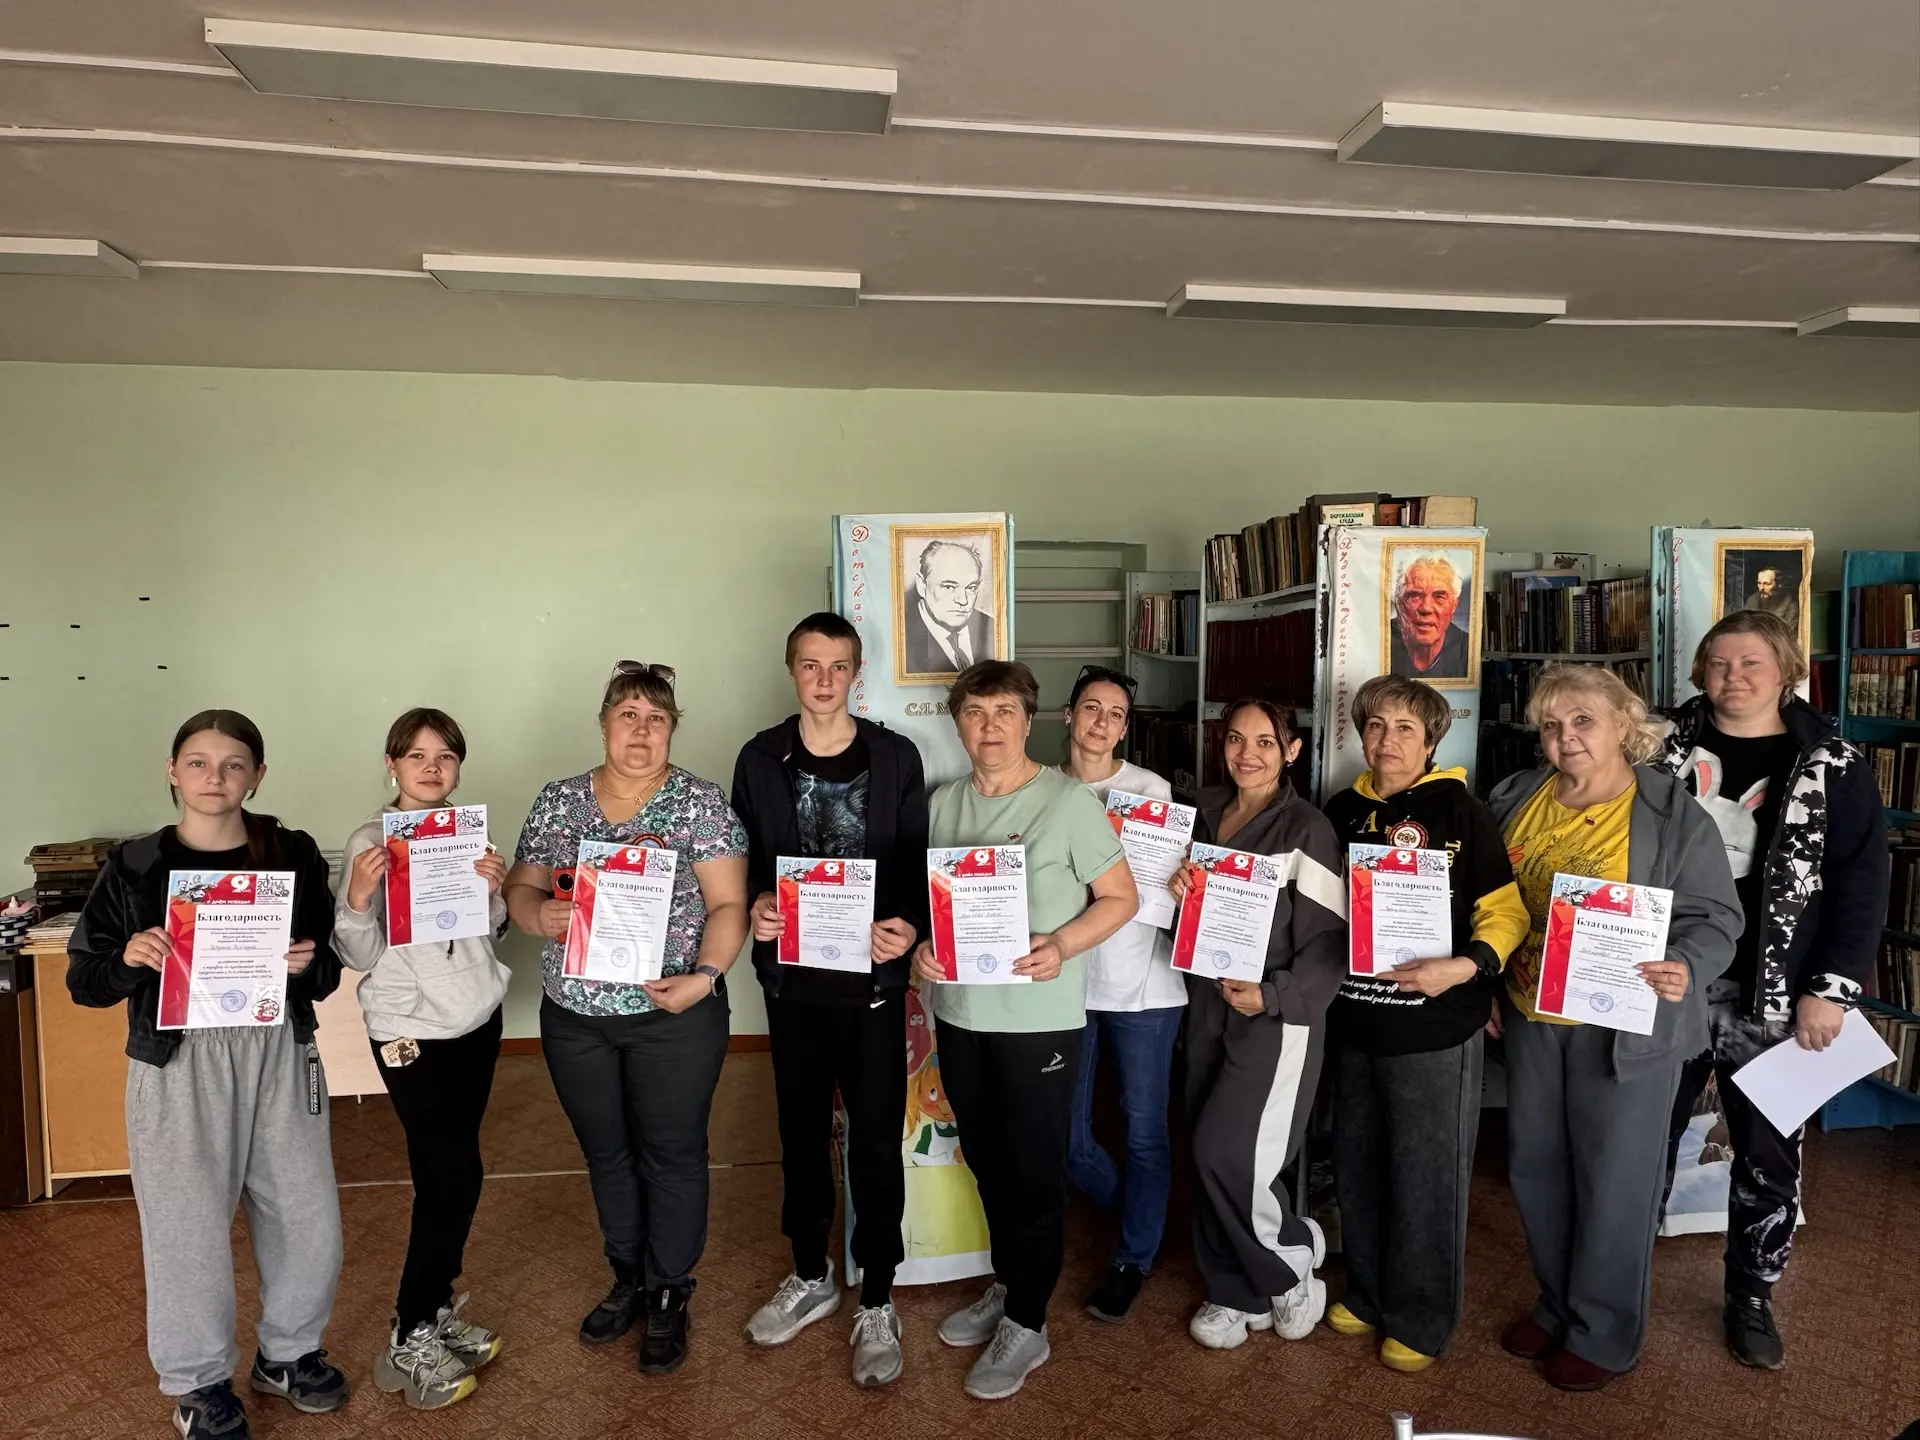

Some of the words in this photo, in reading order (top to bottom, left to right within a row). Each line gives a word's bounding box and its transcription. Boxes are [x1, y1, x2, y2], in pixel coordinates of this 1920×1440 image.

[1122, 826, 1183, 846] Благодарность
[410, 843, 480, 856] Благодарность
[598, 879, 665, 893] Благодарность
[951, 884, 1018, 894] Благодарность
[1207, 880, 1270, 900] Благодарность
[1374, 878, 1442, 892] Благодарность
[800, 890, 867, 901] Благодарность
[197, 912, 282, 924] Благодарность
